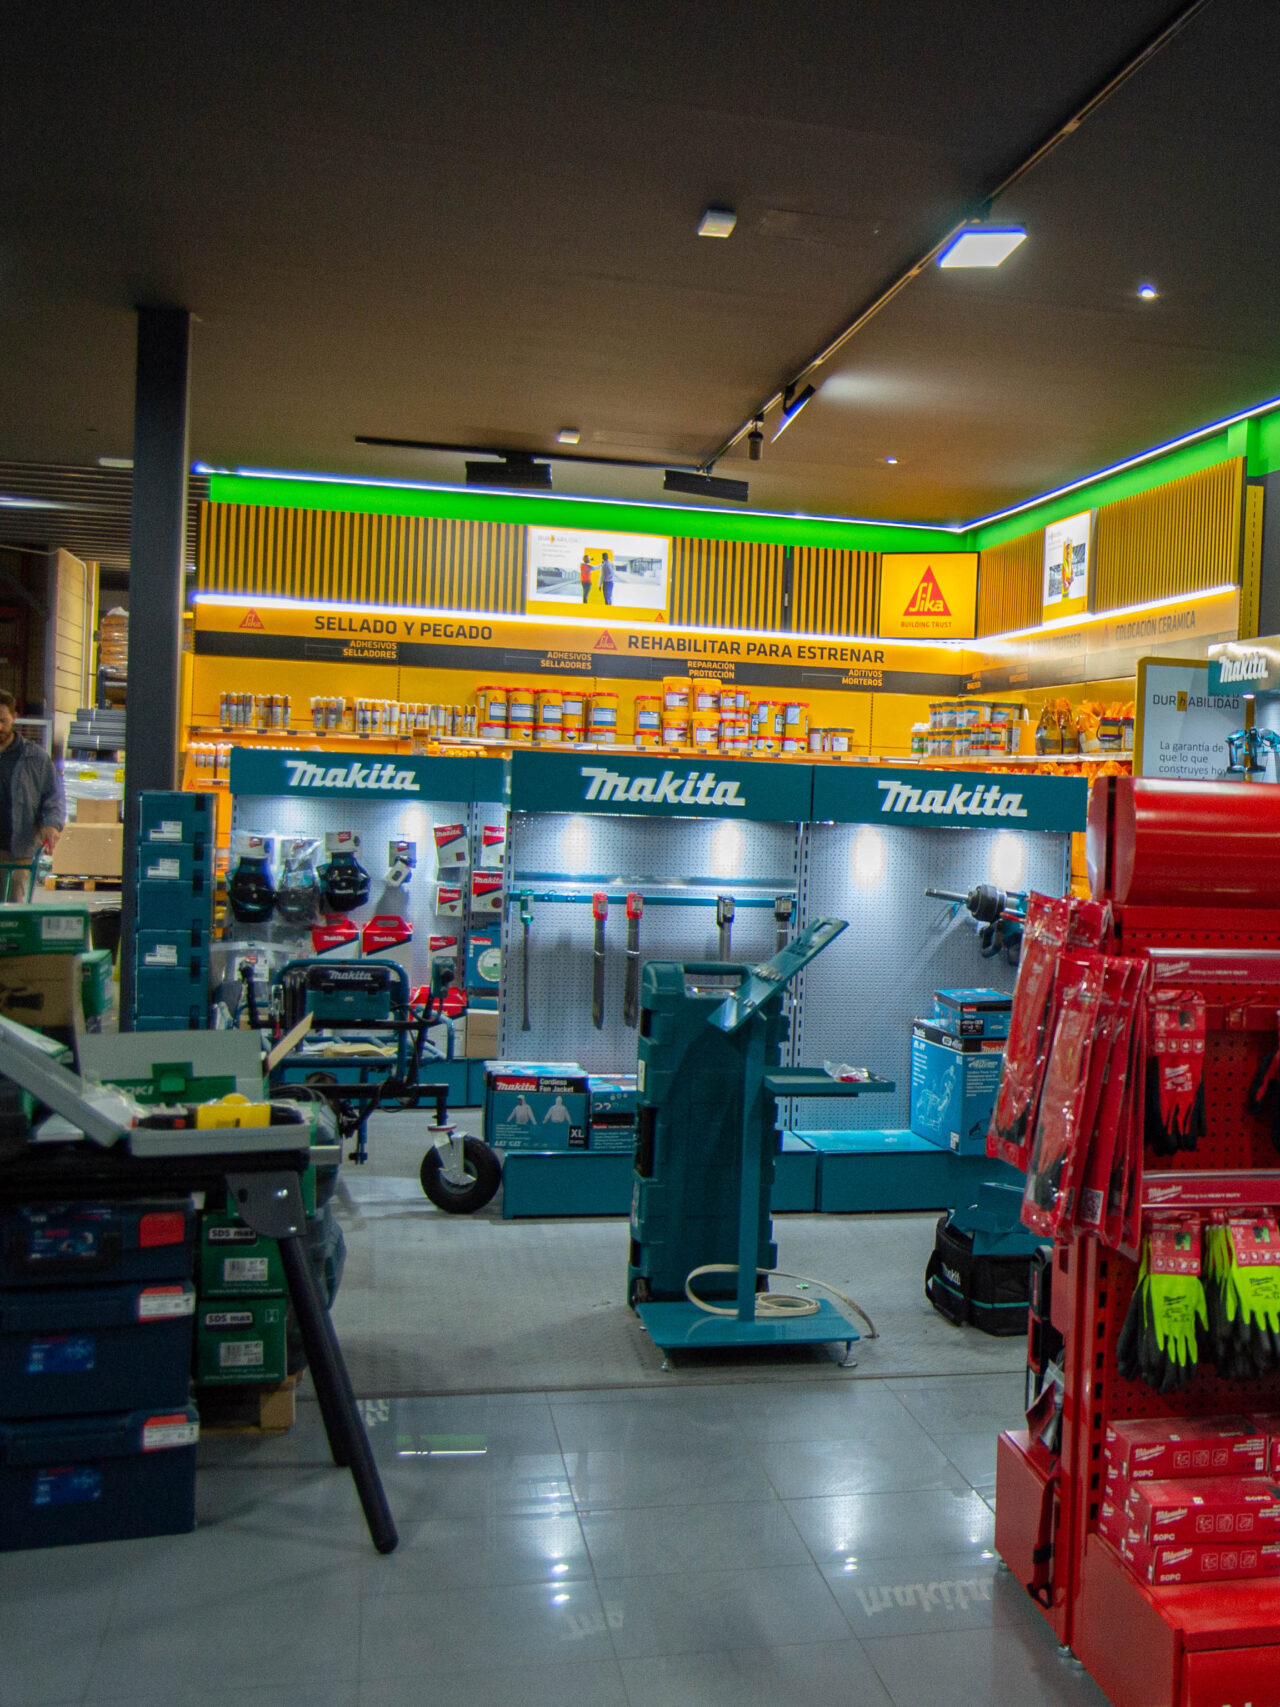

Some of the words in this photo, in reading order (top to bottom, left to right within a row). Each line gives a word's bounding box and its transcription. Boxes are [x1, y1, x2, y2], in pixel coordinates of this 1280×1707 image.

[908, 582, 945, 612] Sika
[314, 615, 398, 636] SELLADO
[403, 620, 416, 638] Y
[420, 622, 493, 641] PEGADO
[350, 640, 397, 650] ADHESIVOS
[628, 634, 741, 657] REHABILITAR
[746, 641, 792, 658] PARA
[797, 645, 885, 664] ESTRENAR
[343, 648, 397, 659] SELLADORES
[546, 651, 592, 662] ADHESIVOS
[540, 659, 592, 670] SELLADORES
[687, 659, 735, 671] REPARACIÓN
[1219, 652, 1269, 684] Makita
[688, 668, 735, 679] PROTECCIÓN
[848, 668, 883, 679] ADITIVOS
[842, 677, 883, 687] MORTEROS
[1160, 741, 1169, 750] La
[1173, 741, 1210, 753] garantía
[1212, 743, 1224, 752] de
[1160, 754, 1177, 763] que
[1180, 753, 1188, 761] lo
[1190, 755, 1208, 764] que
[1159, 764, 1209, 775] construyes
[286, 760, 420, 791] Makita
[580, 766, 746, 806] Makita
[878, 780, 1028, 817] Makita
[329, 970, 373, 980] Makita
[497, 1081, 538, 1091] Makita
[570, 1129, 585, 1138] XL
[211, 1229, 231, 1238] SDS
[208, 1315, 227, 1323] SDS
[230, 1314, 250, 1323] max
